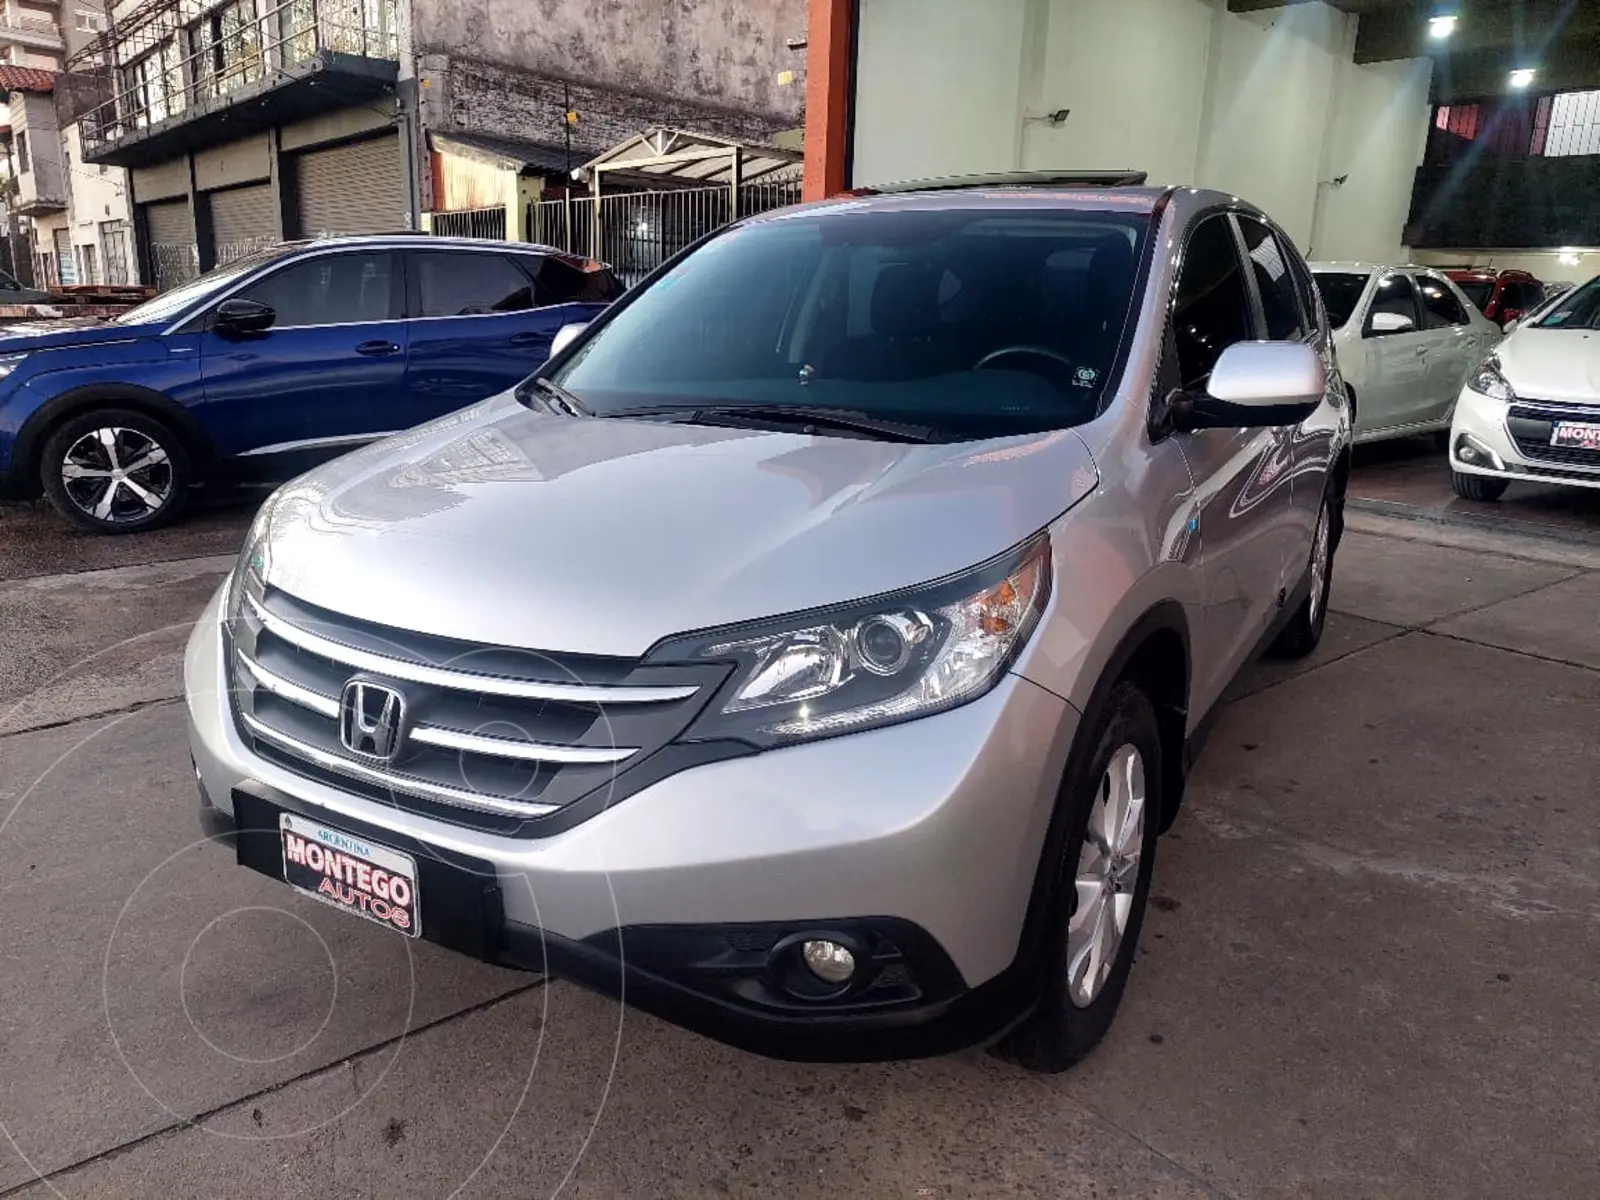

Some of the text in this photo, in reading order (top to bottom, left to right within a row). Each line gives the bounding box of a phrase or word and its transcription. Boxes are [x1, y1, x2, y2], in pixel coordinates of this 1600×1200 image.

[317, 829, 372, 857] ARGENTINA
[286, 833, 411, 907] MONTEGO
[318, 876, 411, 928] AUTOS
